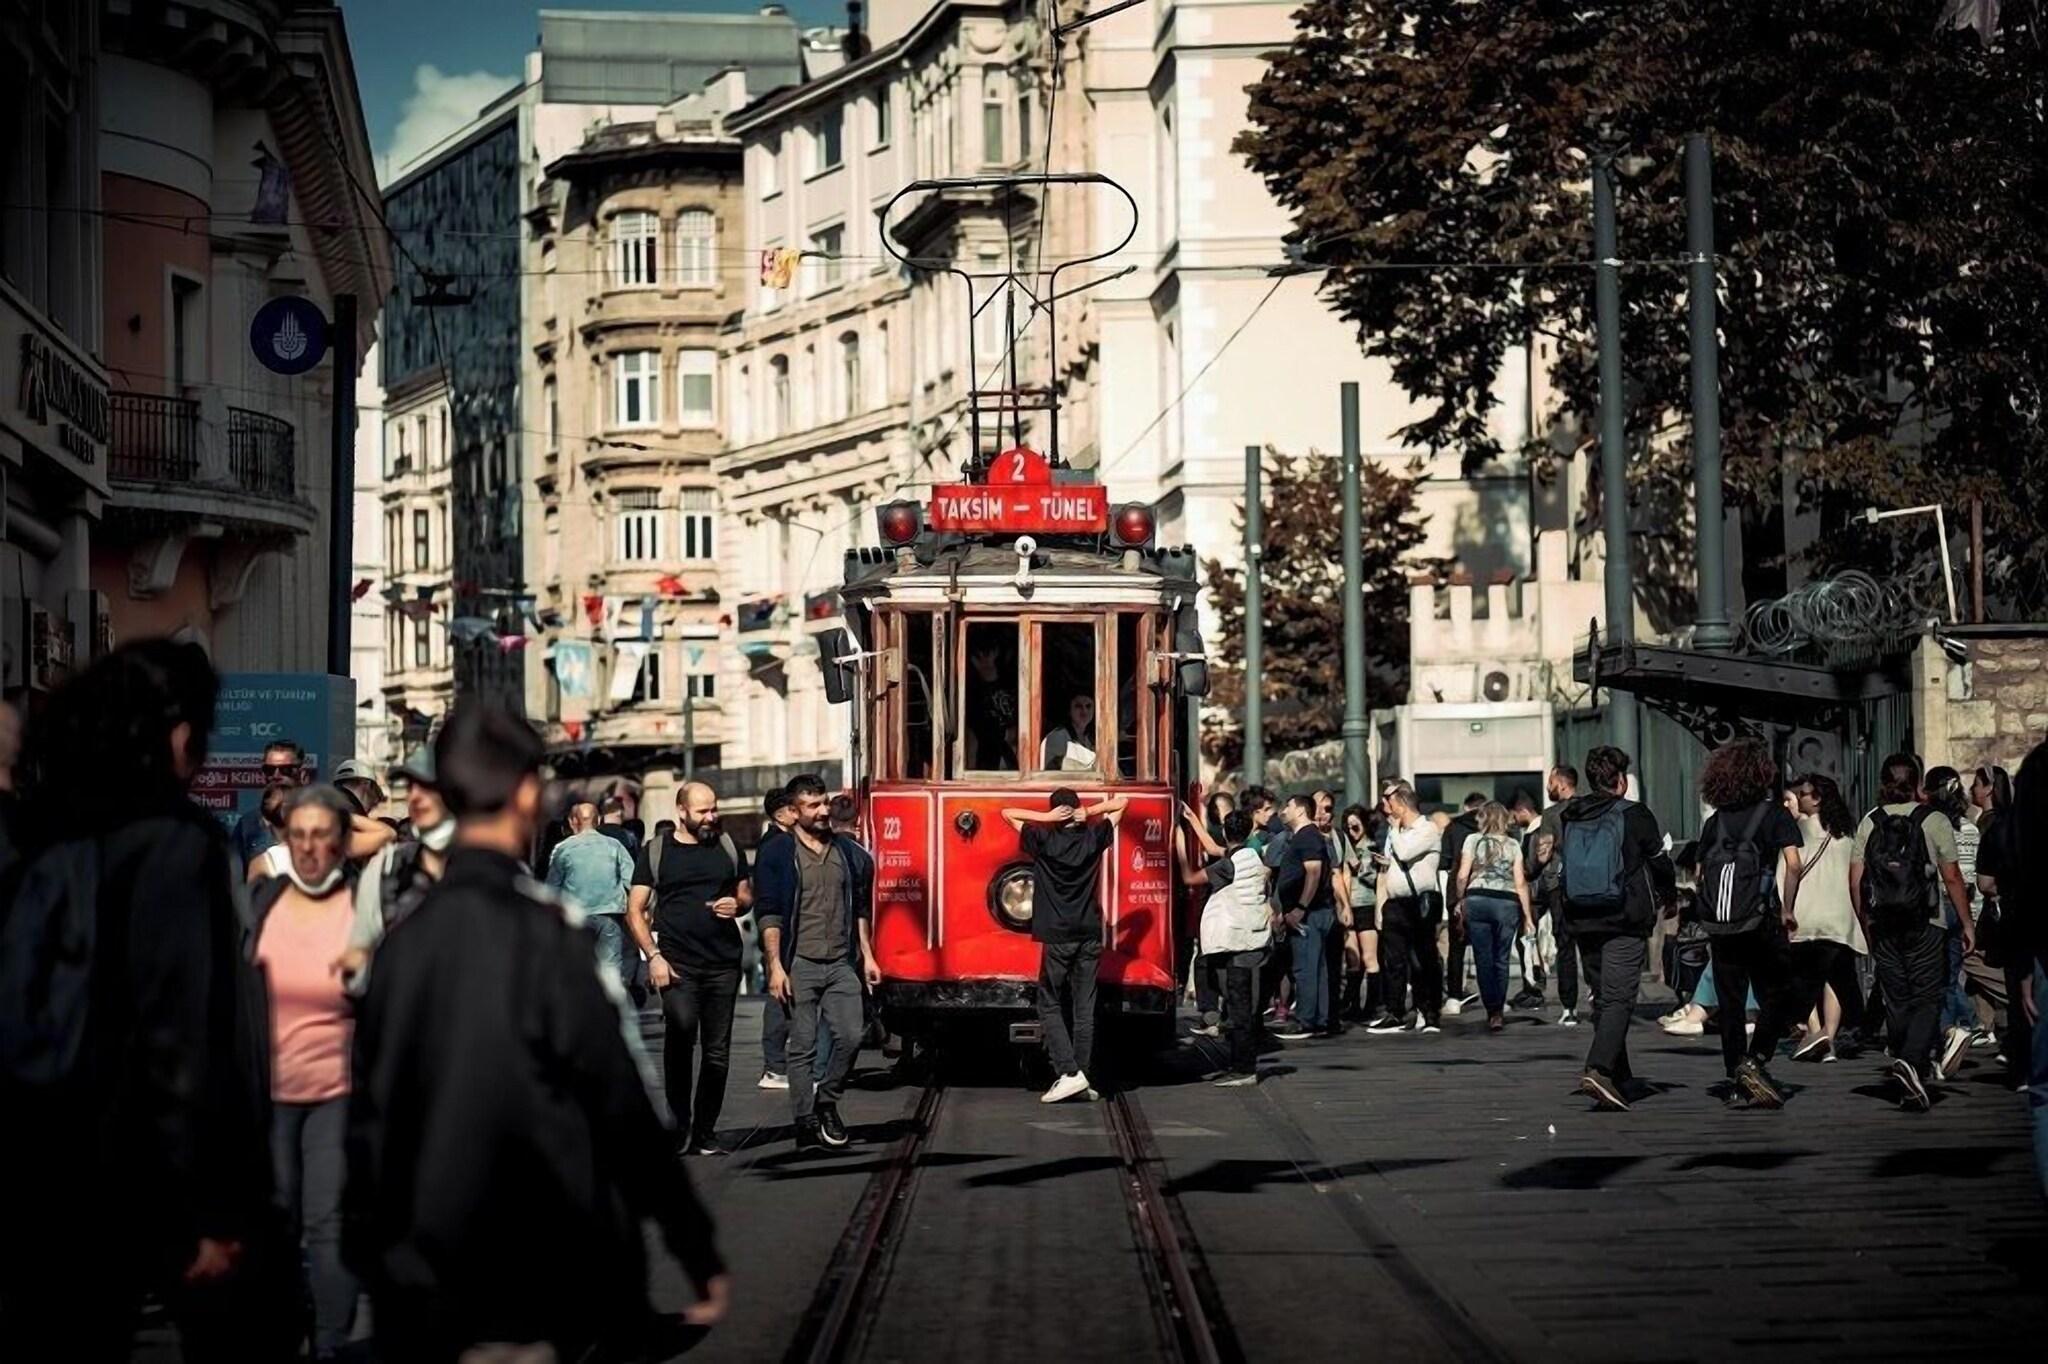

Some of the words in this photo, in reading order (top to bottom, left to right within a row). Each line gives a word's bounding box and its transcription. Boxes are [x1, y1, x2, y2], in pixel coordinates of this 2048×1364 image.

[1011, 453, 1025, 481] 2
[938, 491, 1003, 520] TAKSİM
[1040, 491, 1098, 520] TÜNEL
[883, 817, 902, 840] 223
